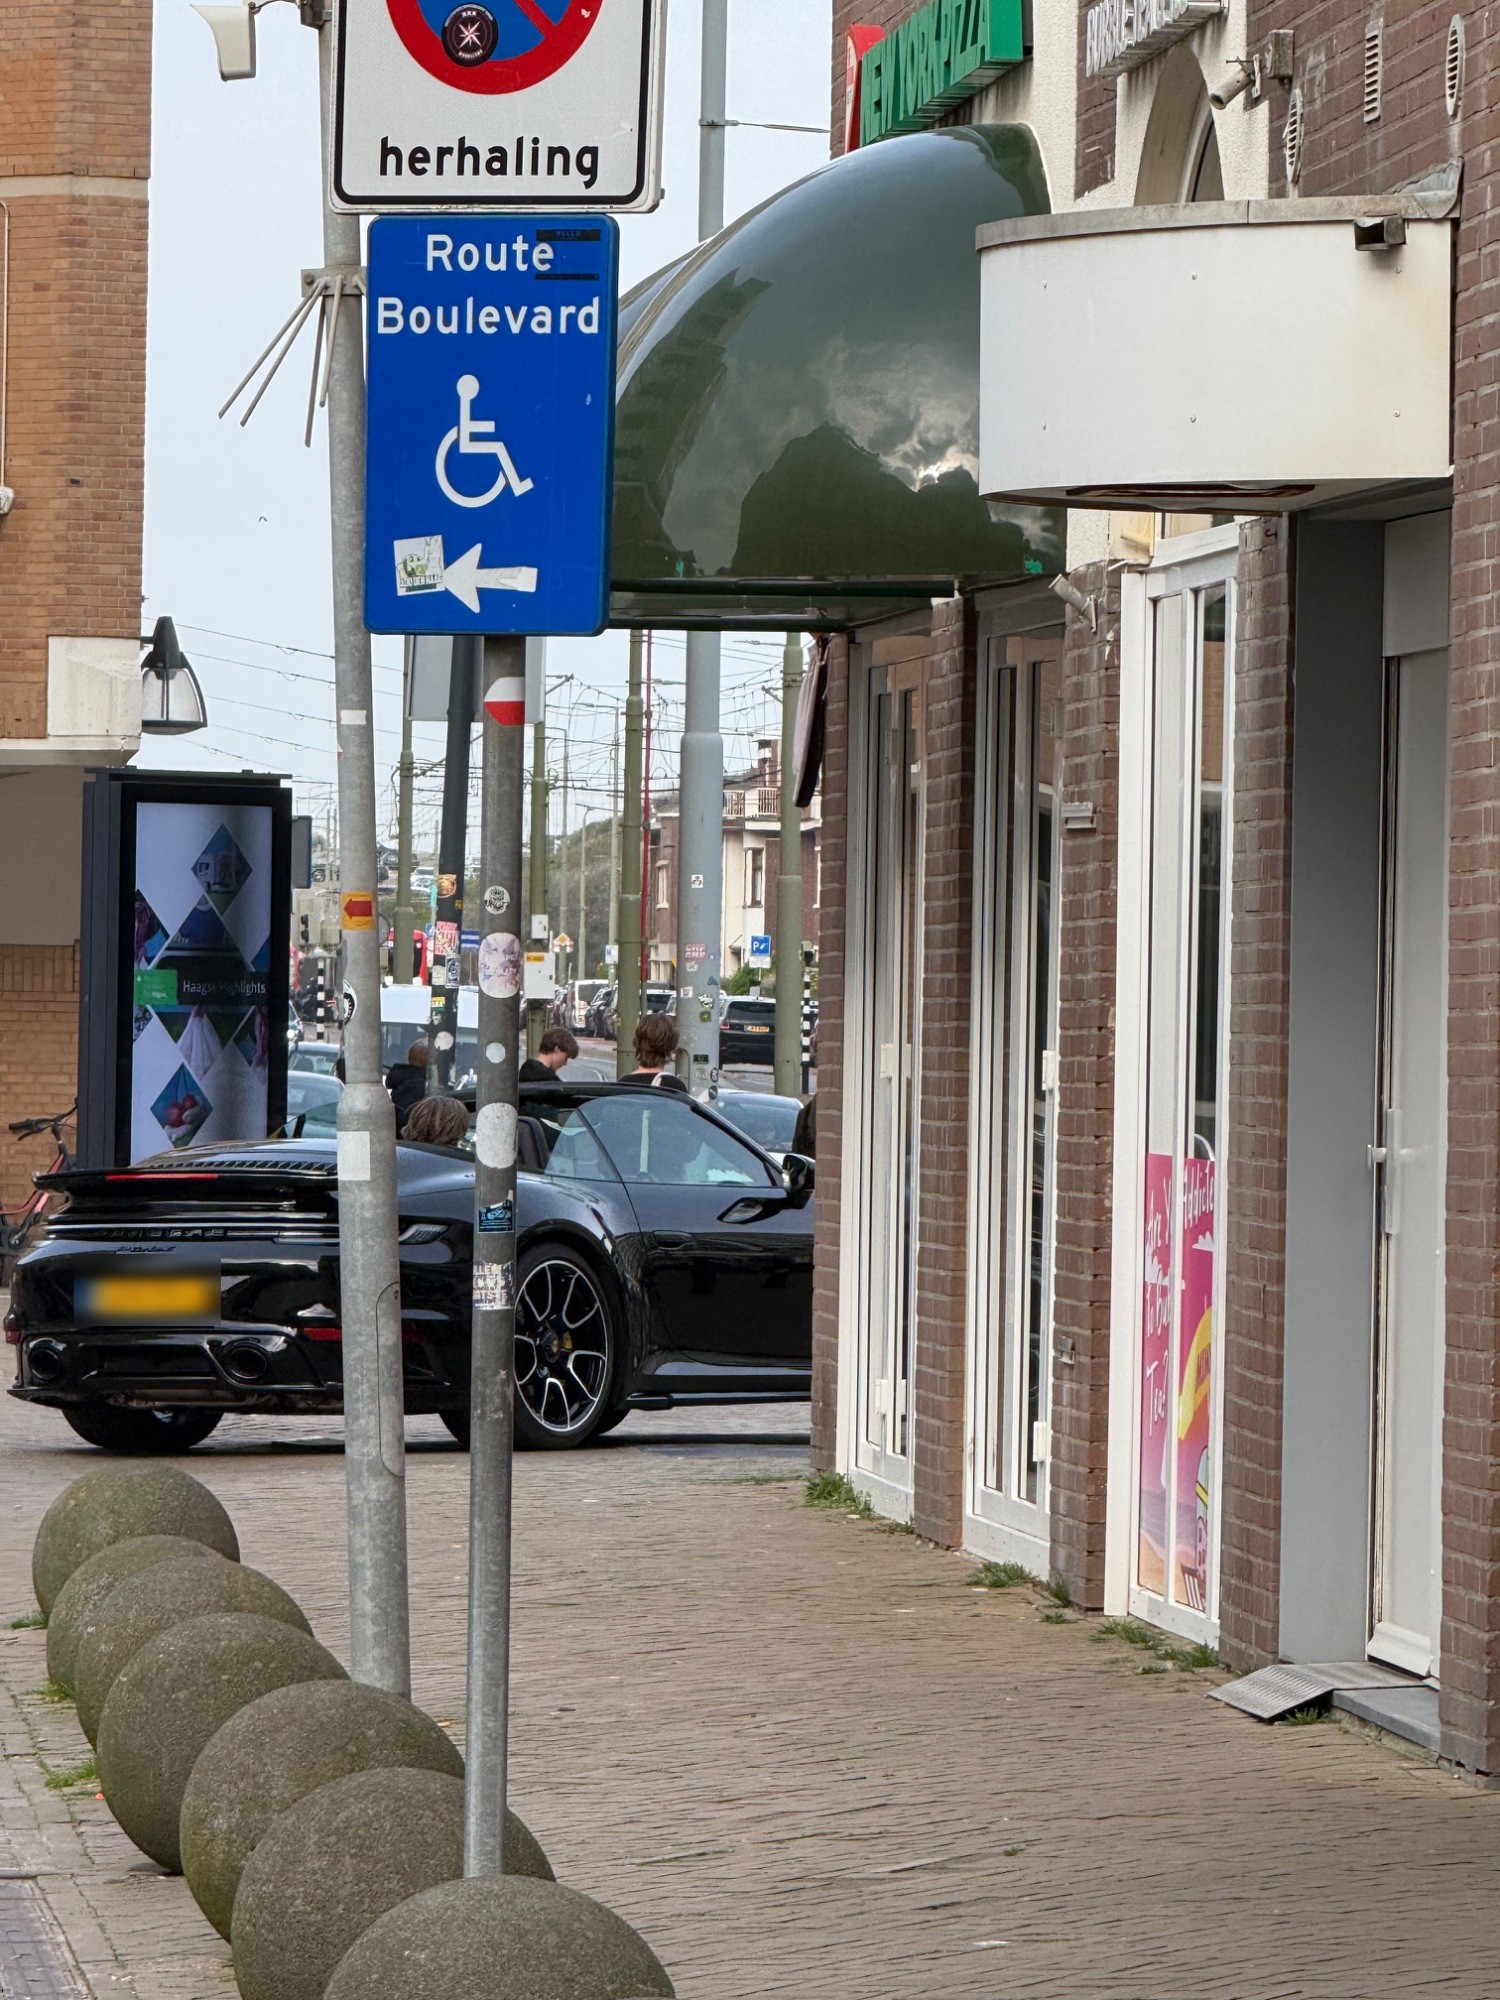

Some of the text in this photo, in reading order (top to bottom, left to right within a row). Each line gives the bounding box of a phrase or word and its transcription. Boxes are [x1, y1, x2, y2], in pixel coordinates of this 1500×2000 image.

[860, 29, 898, 147] NEW
[898, 0, 944, 121] YORK
[941, 0, 991, 91] PIZZA
[379, 136, 600, 190] herhaling
[426, 234, 555, 272] Route
[377, 297, 600, 335] Boulevard
